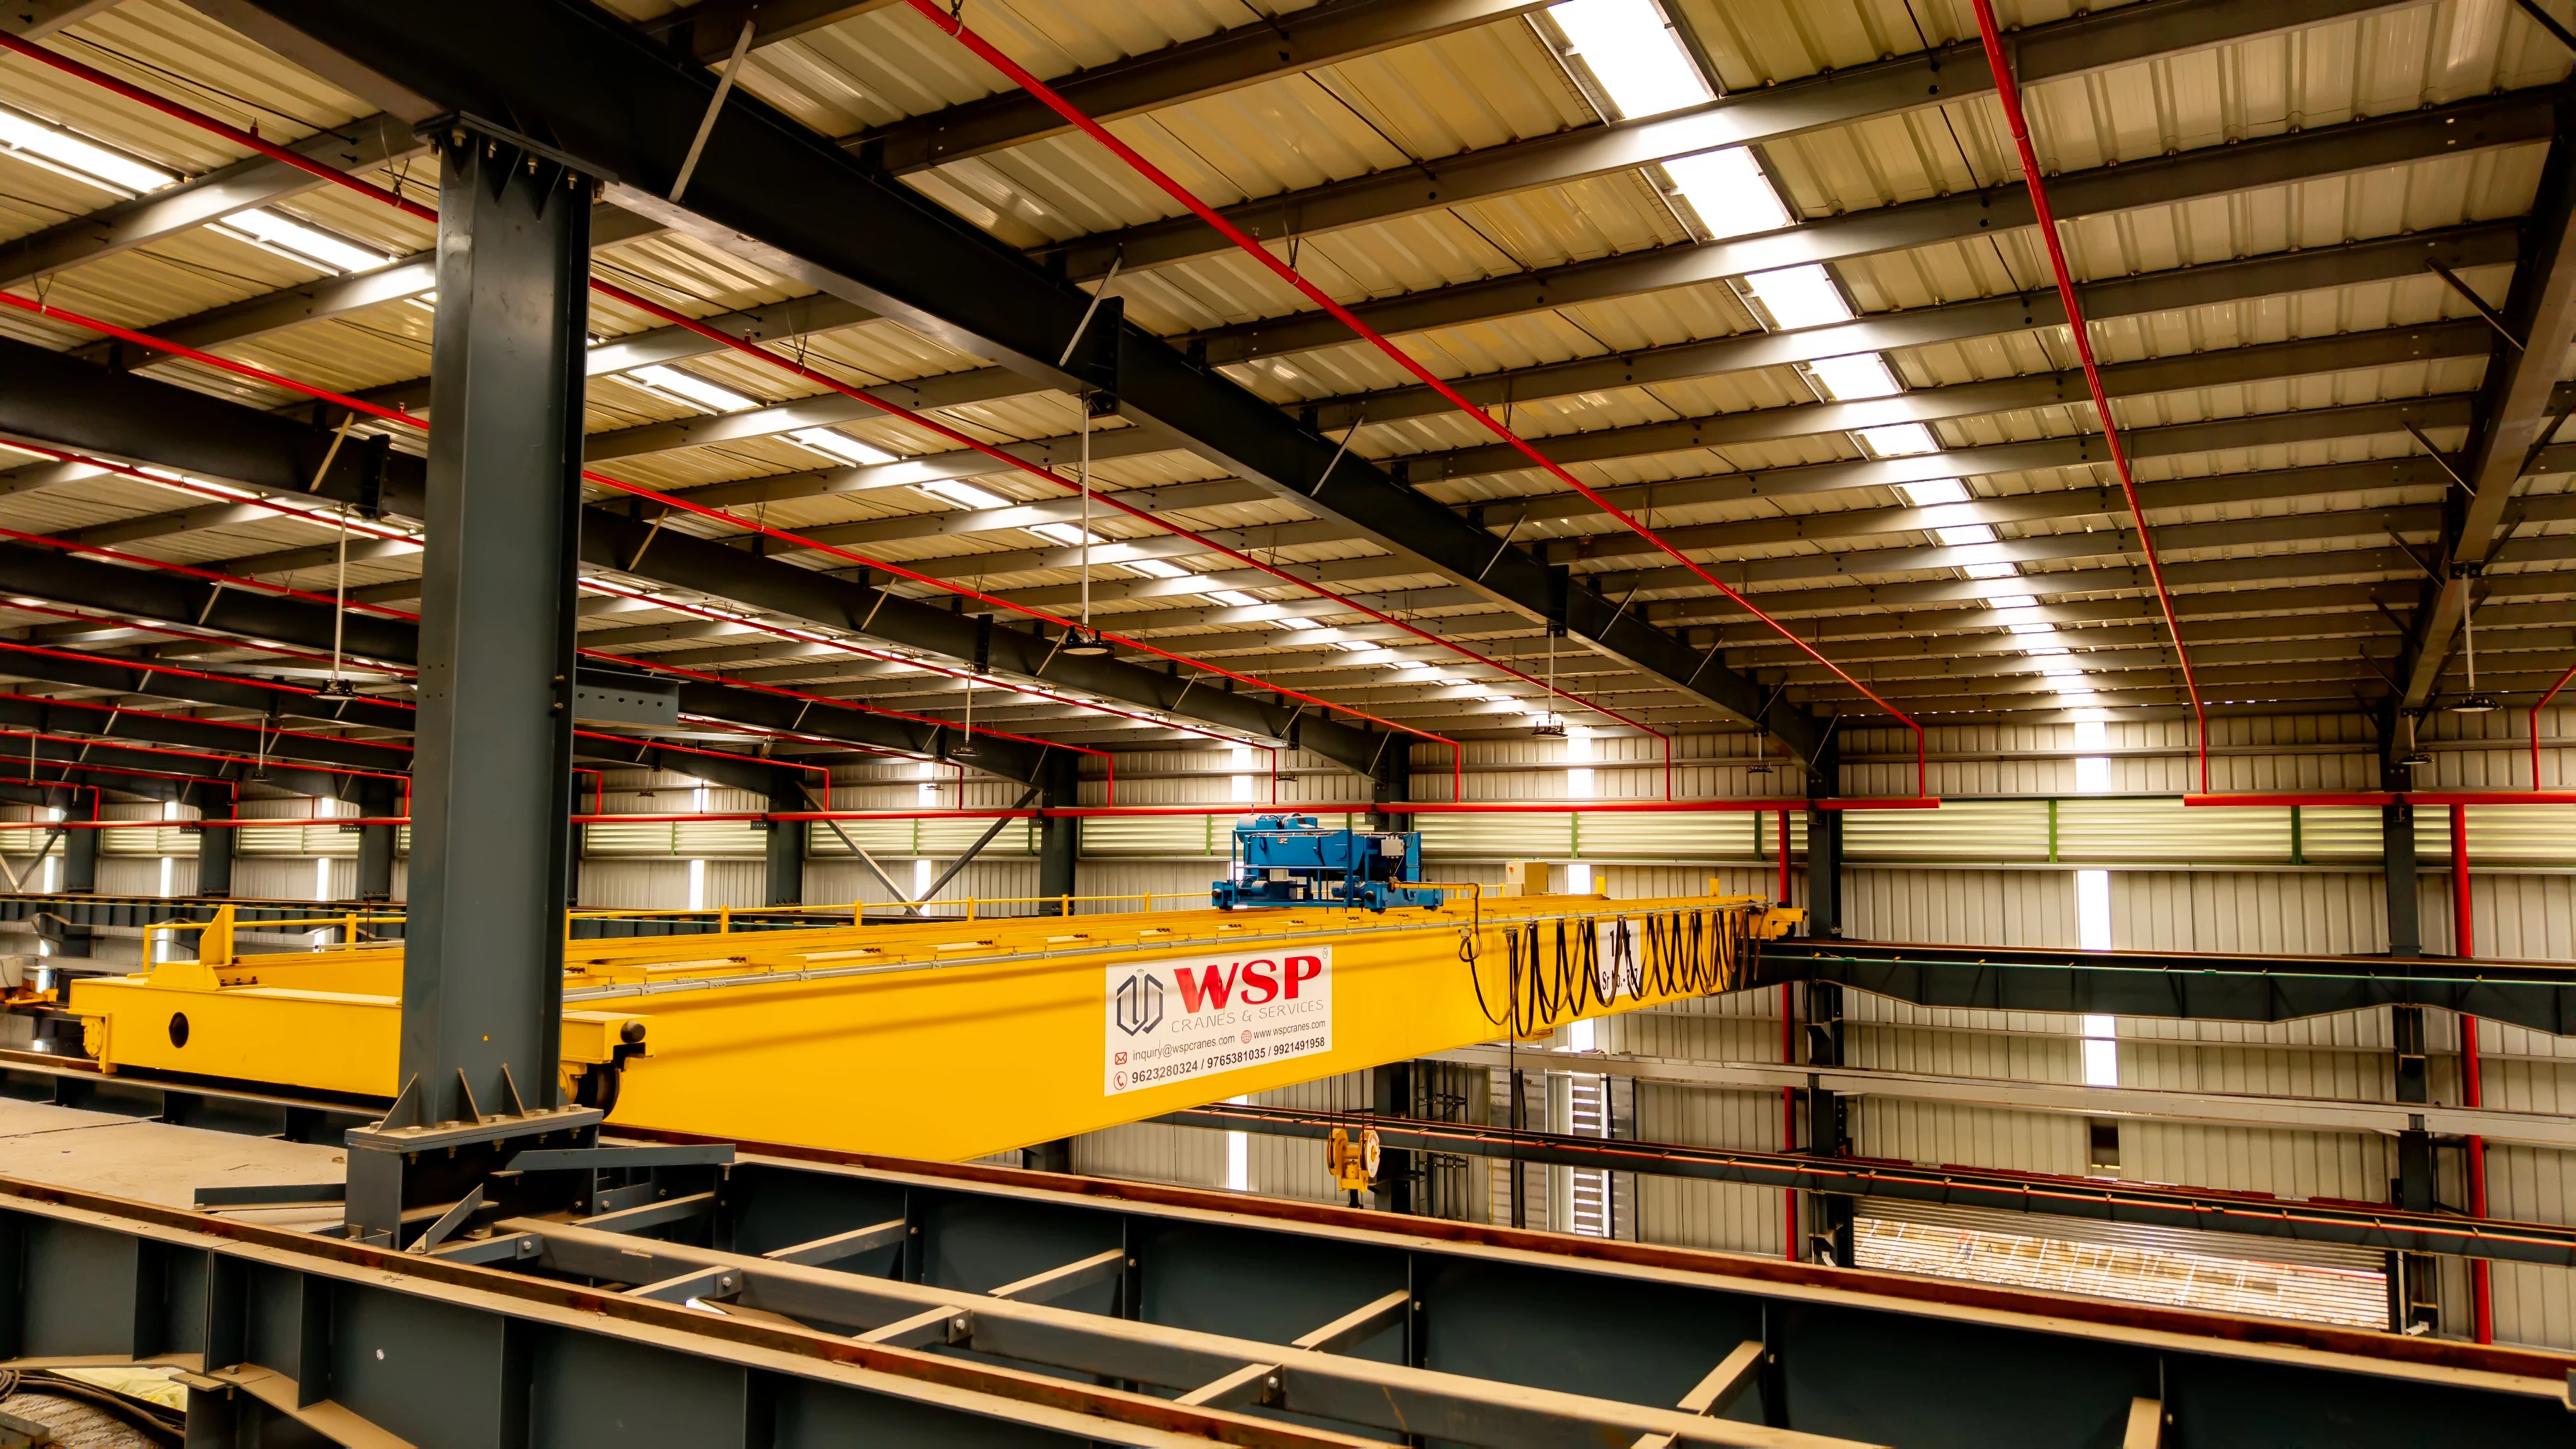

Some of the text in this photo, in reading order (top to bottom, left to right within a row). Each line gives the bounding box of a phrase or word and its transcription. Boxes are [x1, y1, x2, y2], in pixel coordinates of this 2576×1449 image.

[1174, 955, 1322, 1014] WSP
[1602, 971, 1609, 991] Sr
[1172, 999, 1324, 1033] CRANES & SERVICES
[1132, 1036, 1324, 1084] 9623280324 / 9765381035 / 9921491958
[1133, 1020, 1325, 1062] inquiry@wspcranes.com www.wspcranes.com
